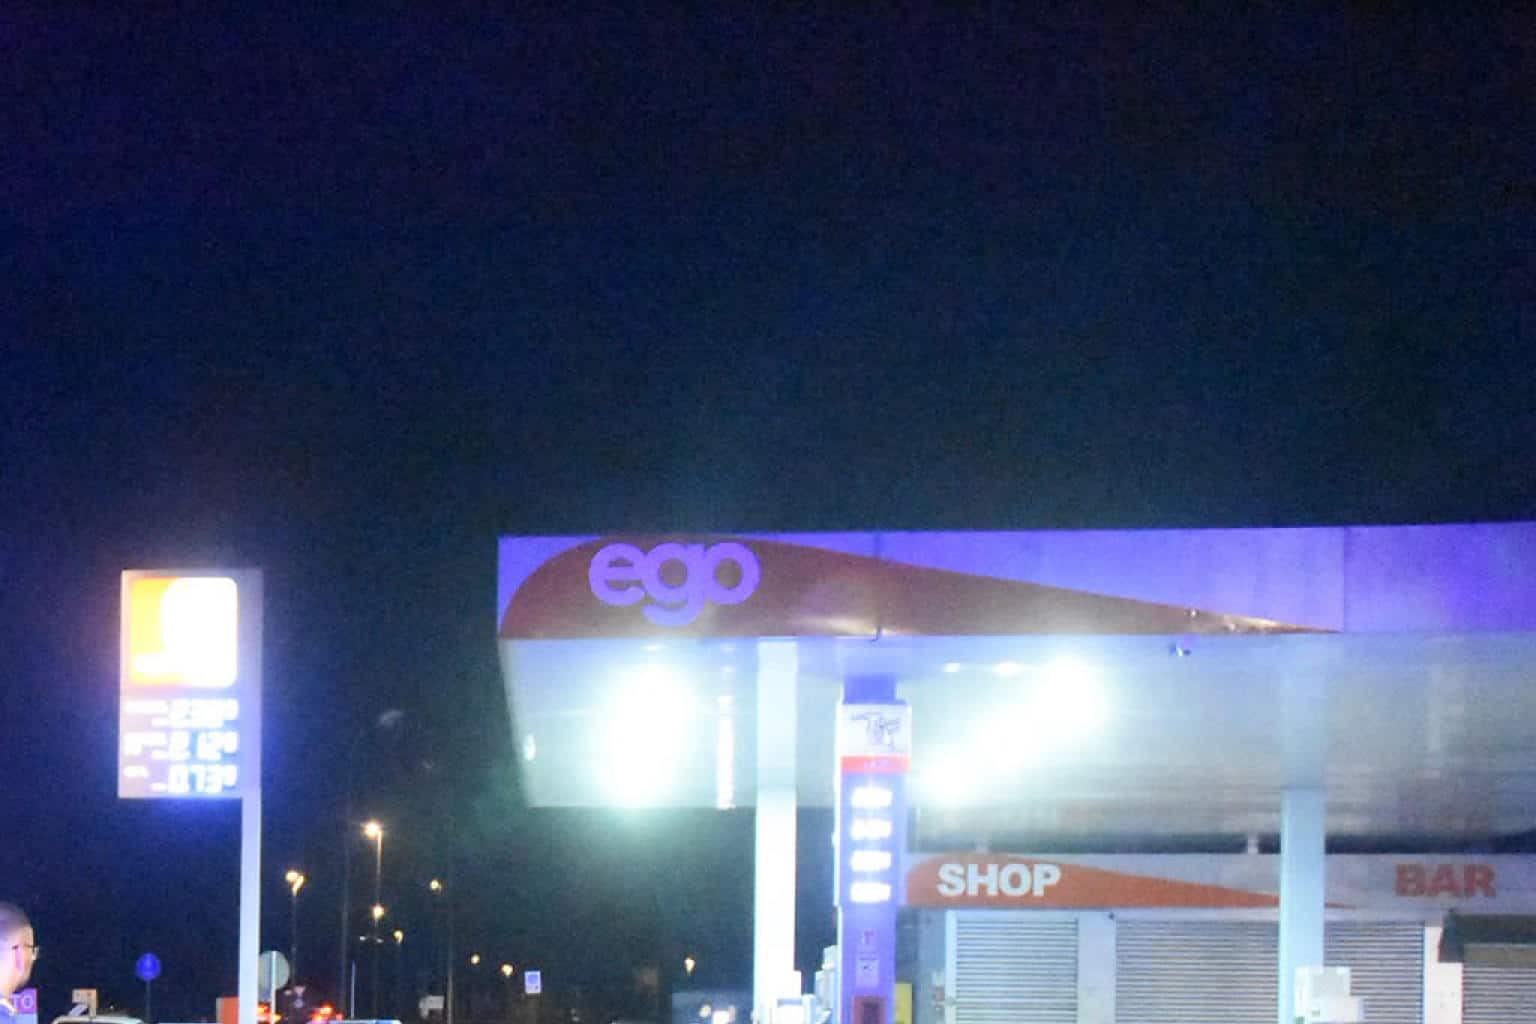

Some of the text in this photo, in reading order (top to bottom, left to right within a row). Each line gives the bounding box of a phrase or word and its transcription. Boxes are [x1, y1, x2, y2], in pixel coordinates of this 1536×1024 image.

[589, 542, 760, 626] ego
[937, 863, 1061, 896] SHOP
[1396, 864, 1497, 897] BAR
